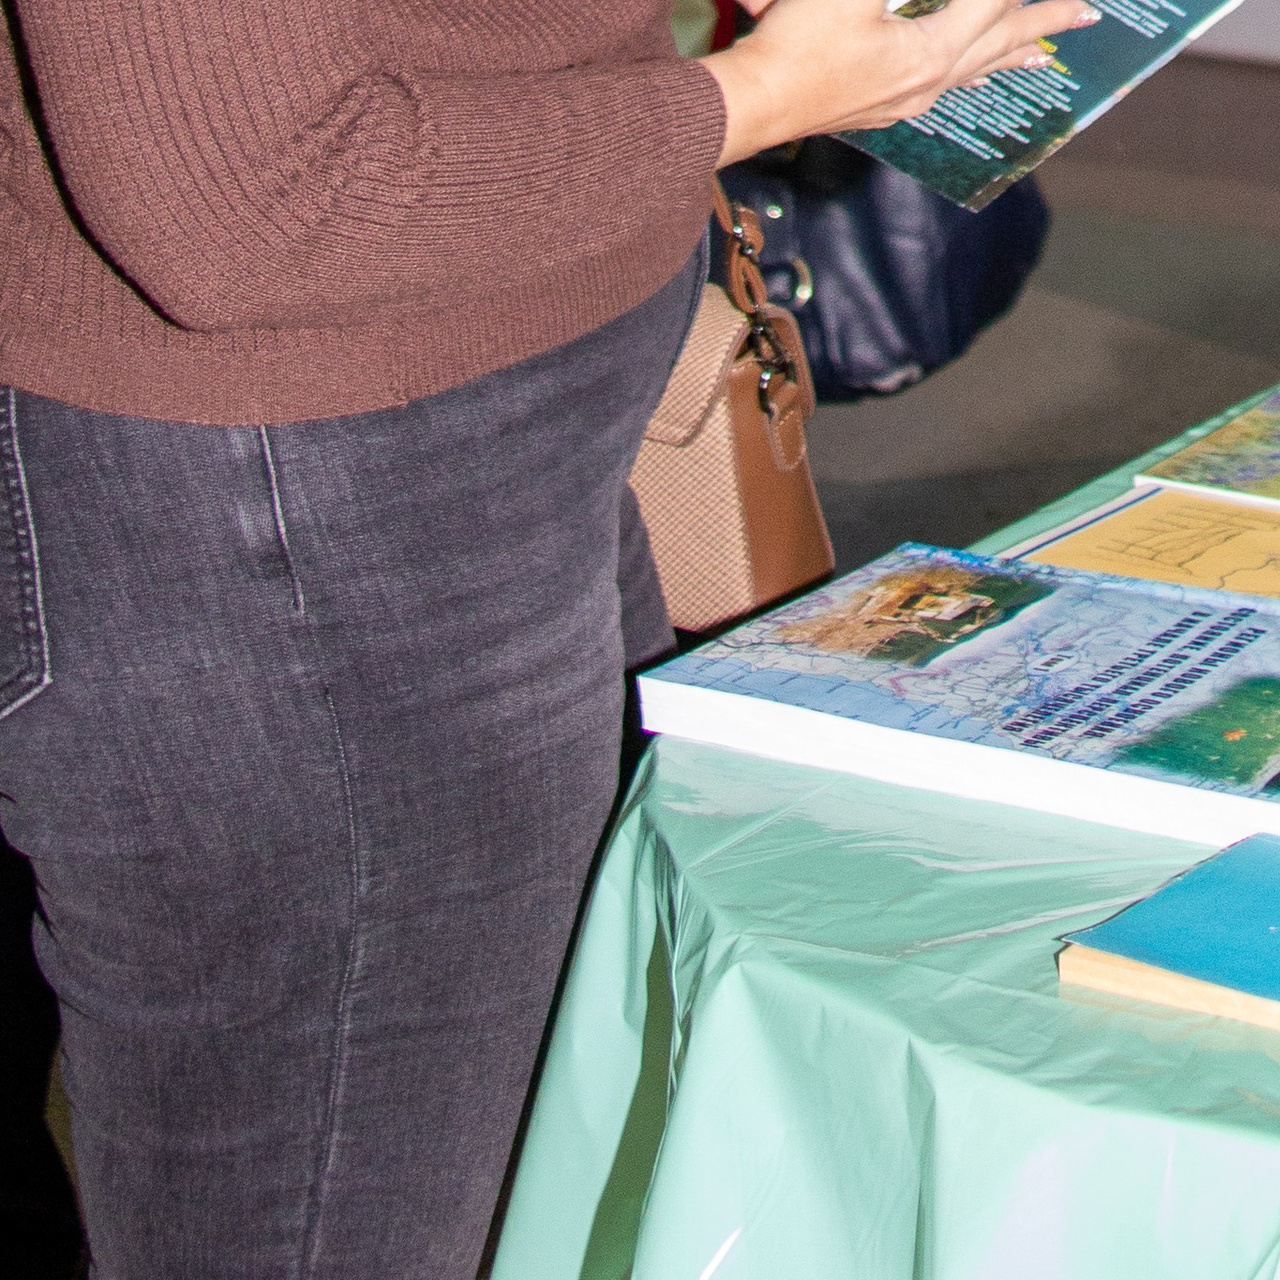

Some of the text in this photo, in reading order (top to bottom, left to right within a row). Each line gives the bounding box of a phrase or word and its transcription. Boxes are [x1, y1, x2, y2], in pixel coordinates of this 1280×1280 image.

[1144, 617, 1202, 649] НАЧАЛЕ
[1197, 626, 1267, 668] РЕГИОНЫ
[1040, 654, 1074, 667] Том
[1089, 648, 1157, 683] ТРЕТЬЕГО
[1148, 666, 1210, 699] НОВОГО
[999, 682, 1100, 734] ТЫСЯЧЕЛЕТИЯ
[1018, 697, 1119, 749] ПЕРСПЕКТИВЫ
